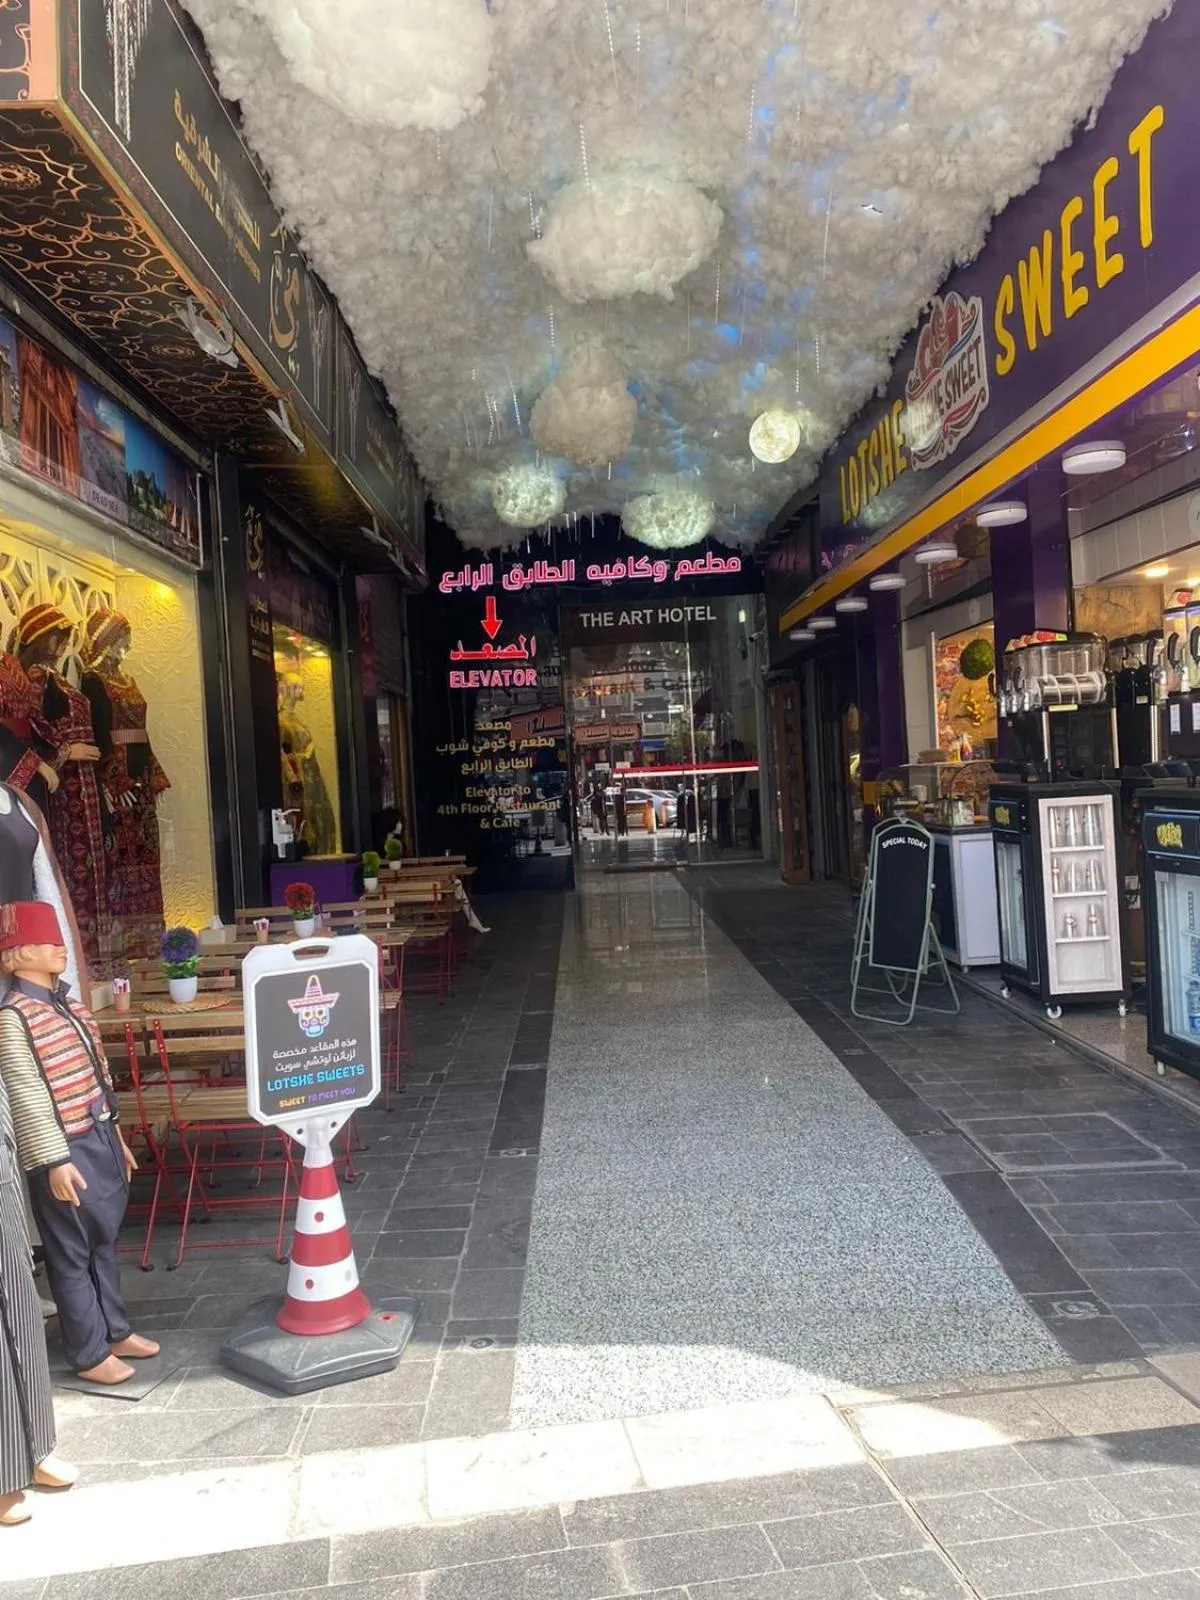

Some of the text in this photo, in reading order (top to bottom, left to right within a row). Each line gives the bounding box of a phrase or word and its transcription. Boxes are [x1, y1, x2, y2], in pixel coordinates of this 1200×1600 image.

[839, 104, 1165, 526] LOTSHE SWEET
[944, 335, 982, 411] SWEET
[438, 552, 741, 593] مطعم وكافيه الطابق الرابع
[580, 606, 716, 628] THE ART HOTEL
[450, 634, 537, 661] المصعد
[449, 668, 538, 688] ELEVATOR
[475, 720, 511, 731] مصعد
[436, 739, 469, 754] شوب
[472, 739, 507, 756] كوفي
[519, 736, 555, 749] مطعم
[461, 757, 533, 775] الطابق الرابع
[465, 785, 531, 798] Elevator to
[436, 798, 561, 816] 4th Floor Restaurant
[480, 818, 490, 829] &
[881, 836, 928, 850] SPECIAL TODAY
[272, 1038, 357, 1059] هذه المقاعد مخصصة
[275, 1048, 356, 1073] لزبائن لوتشي سويت
[267, 1063, 365, 1092] LOTSHE SWEETS
[278, 1087, 355, 1108] SWEET TO MEET YOU
